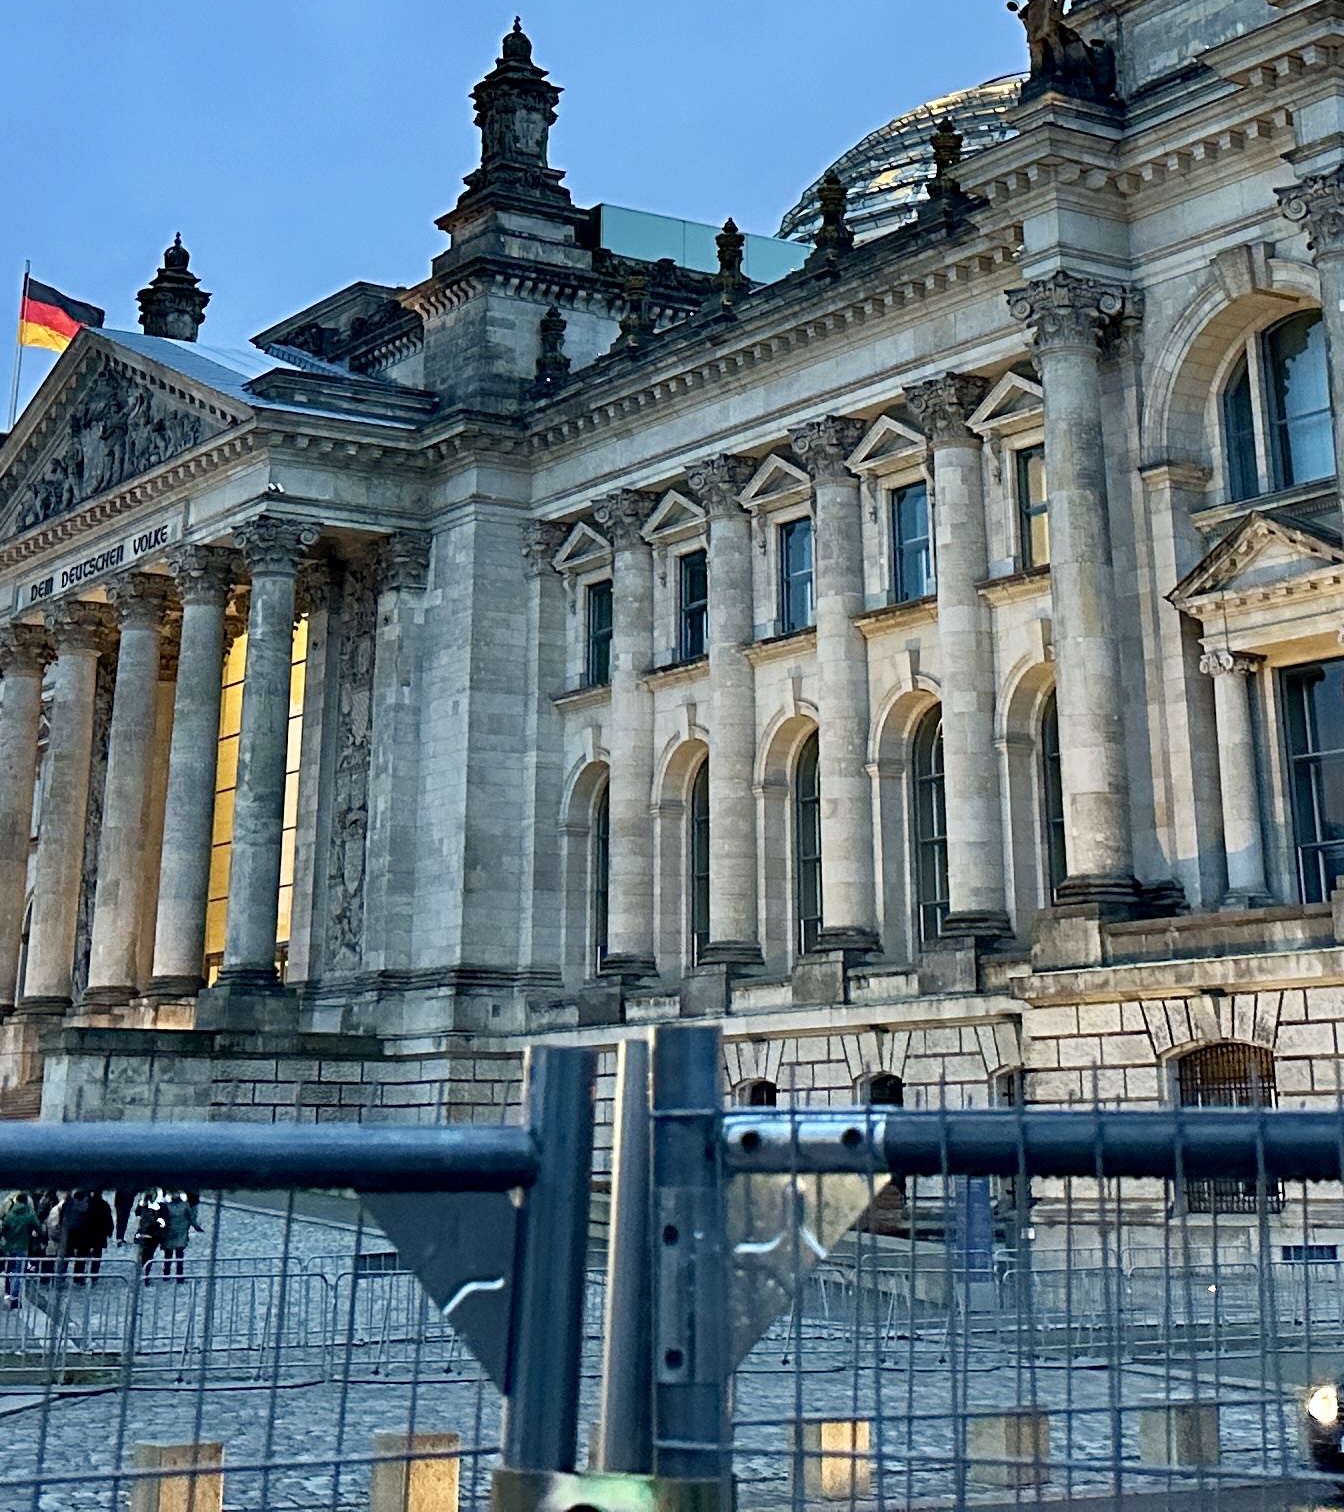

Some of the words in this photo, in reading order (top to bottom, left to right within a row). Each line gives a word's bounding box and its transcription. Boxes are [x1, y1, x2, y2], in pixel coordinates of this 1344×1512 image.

[31, 577, 54, 602] DEM
[61, 545, 124, 588] DEUTSCHEN
[133, 525, 168, 555] VOLKE
